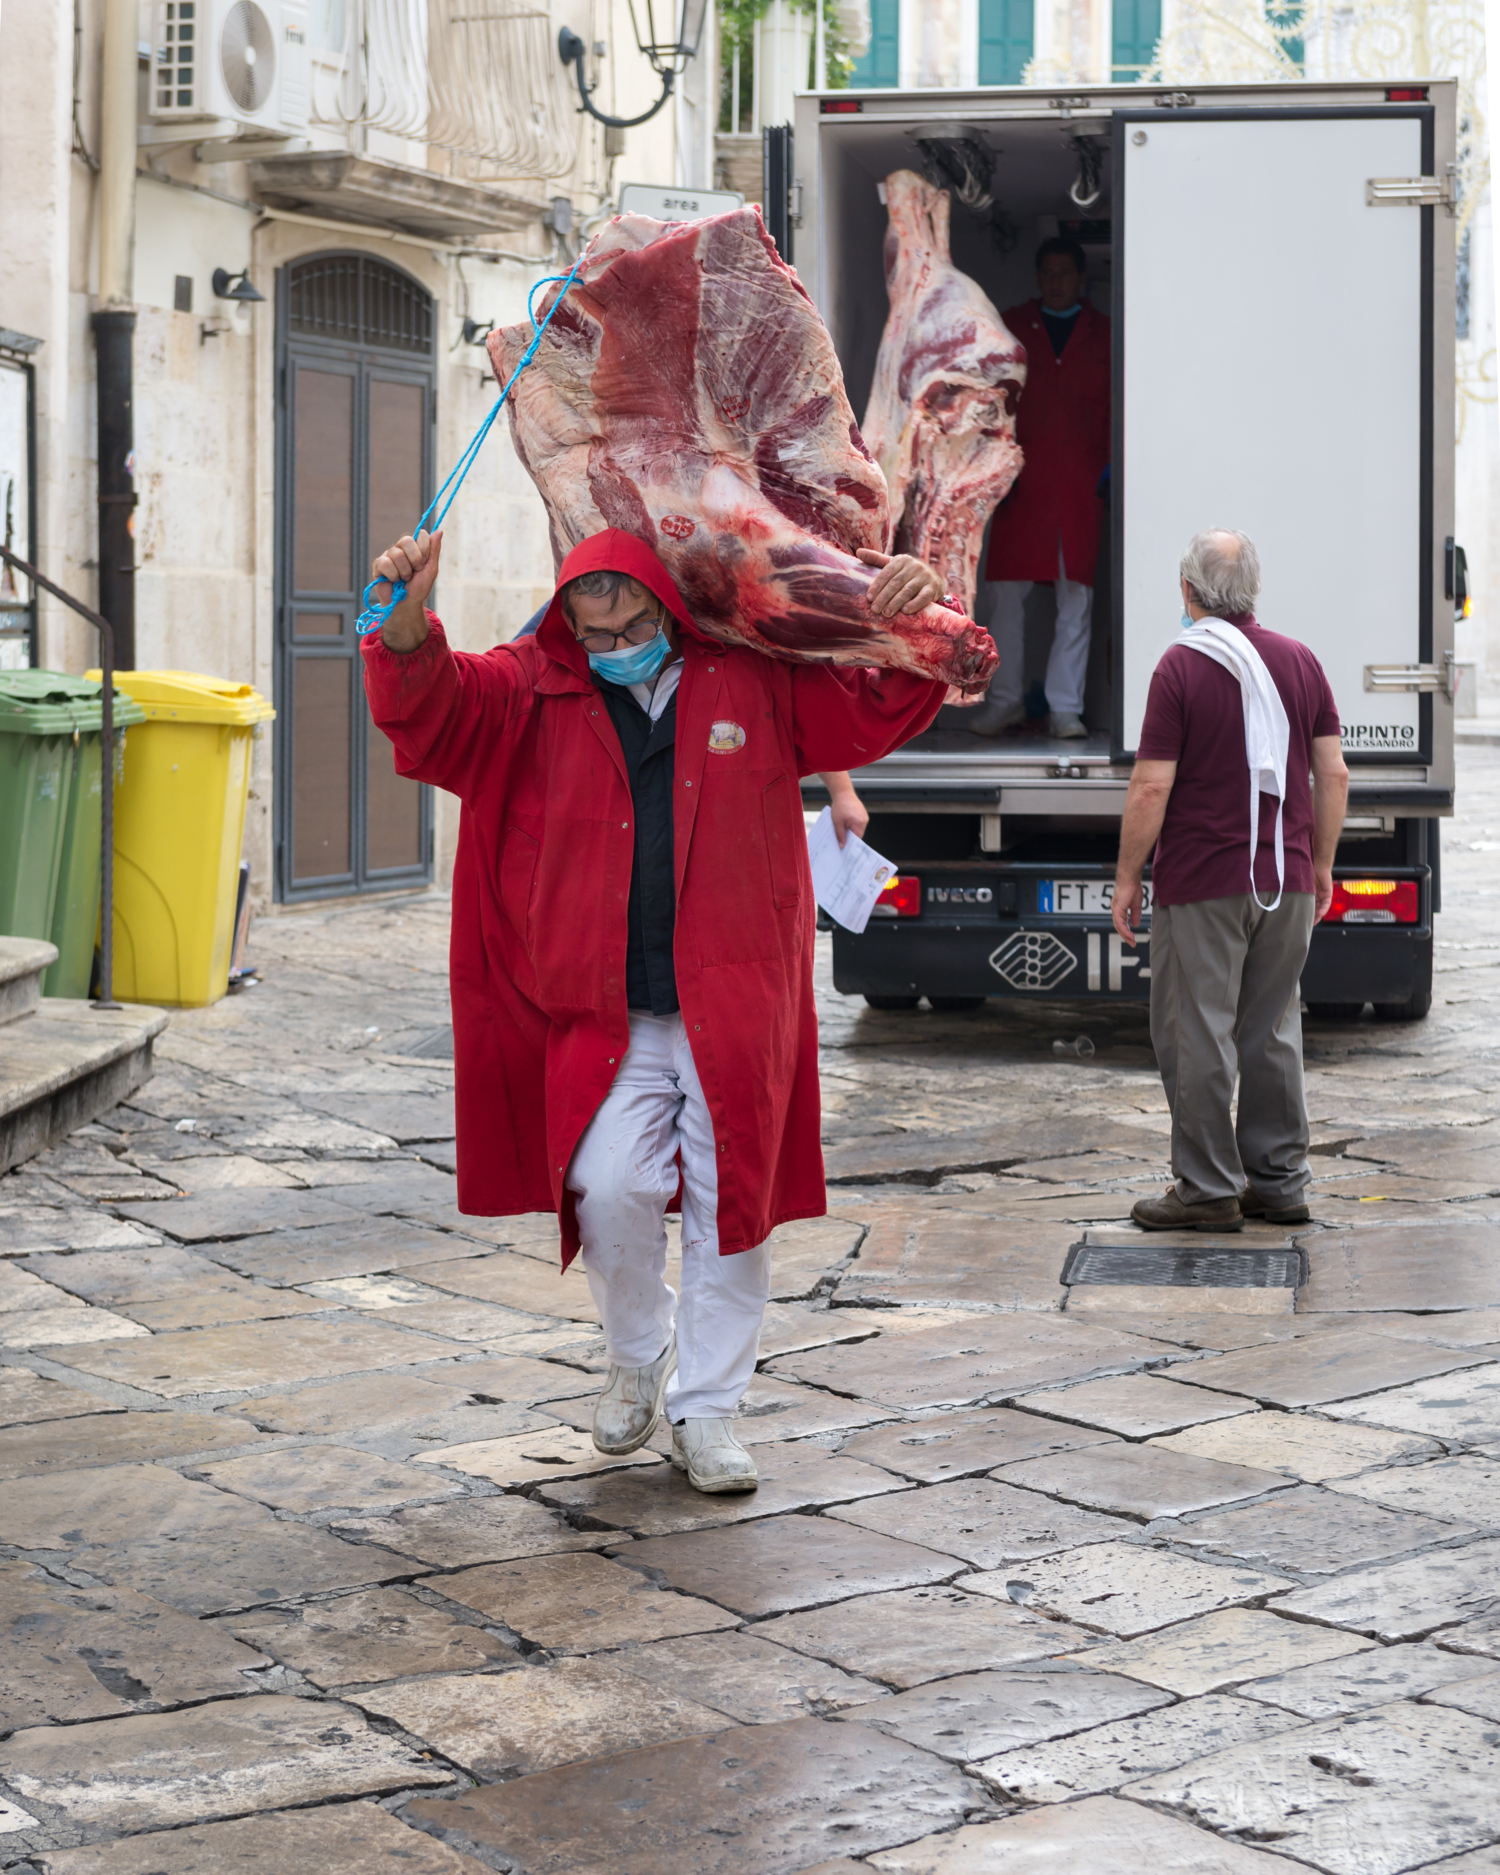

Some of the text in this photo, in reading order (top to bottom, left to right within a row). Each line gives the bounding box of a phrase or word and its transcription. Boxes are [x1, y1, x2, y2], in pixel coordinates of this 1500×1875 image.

[663, 199, 699, 211] area
[1340, 725, 1414, 738] DIPINTO
[1340, 739, 1414, 748] ALESSANDRO
[927, 887, 993, 903] IVECO
[1058, 884, 1089, 910] FT
[1087, 933, 1151, 991] IF
